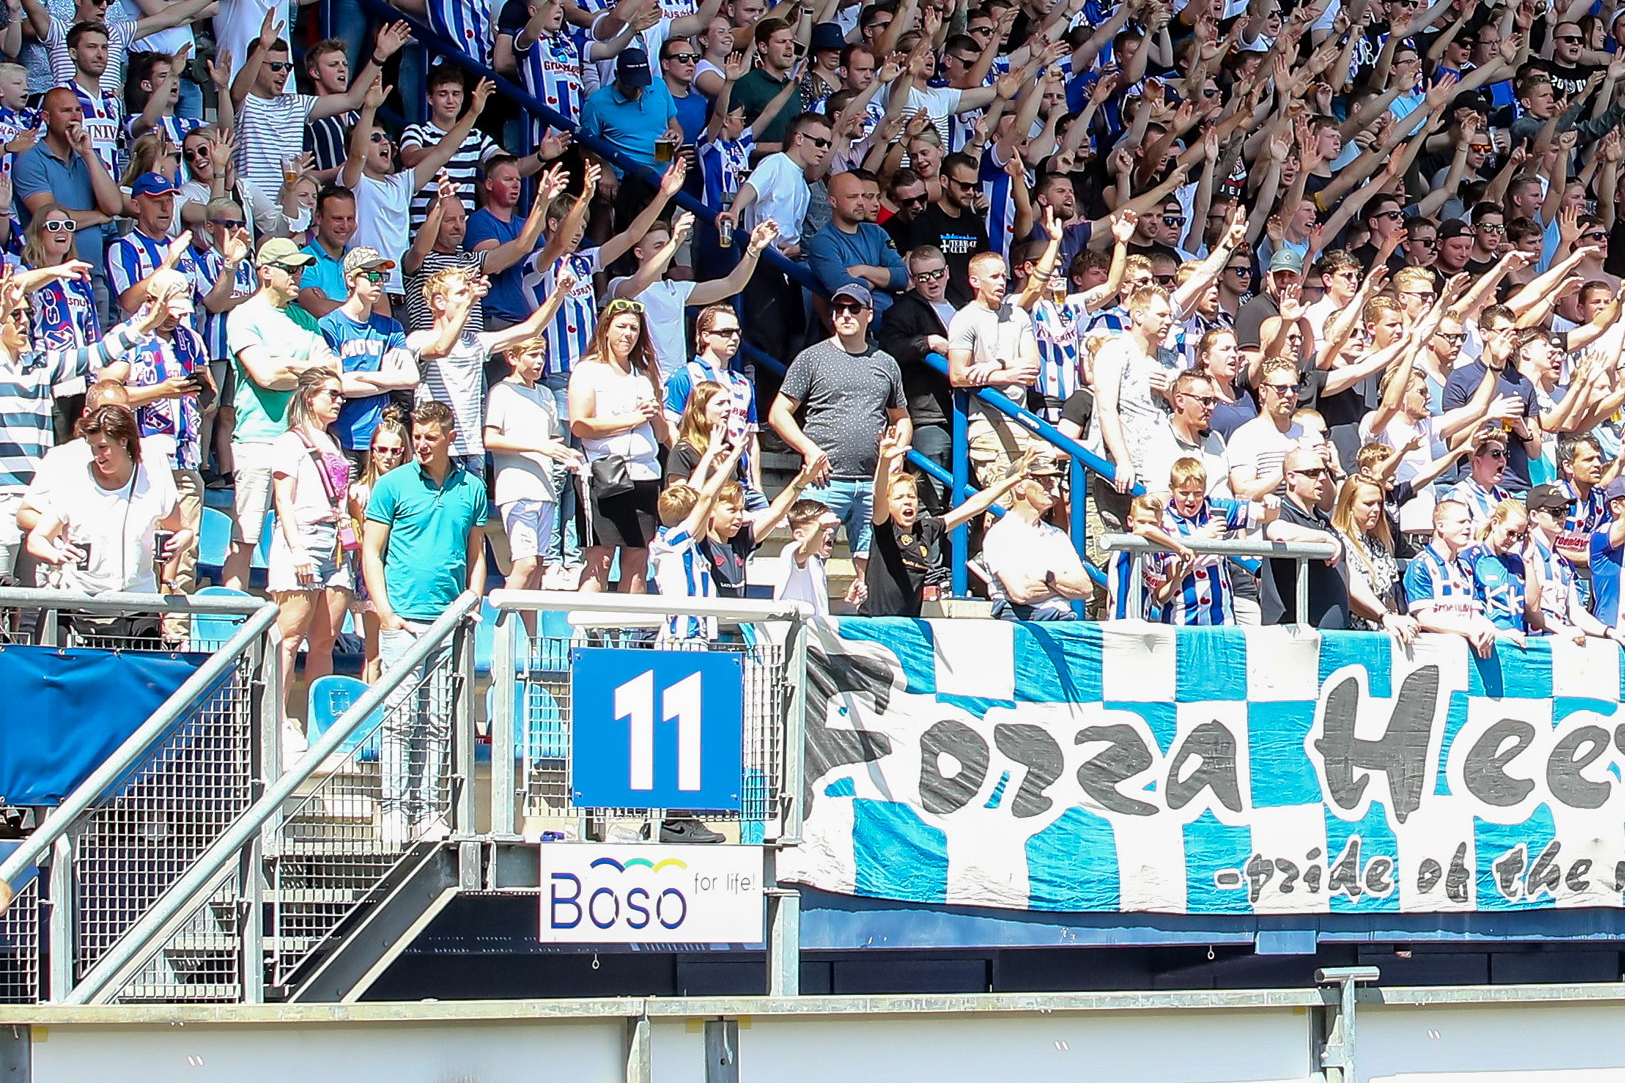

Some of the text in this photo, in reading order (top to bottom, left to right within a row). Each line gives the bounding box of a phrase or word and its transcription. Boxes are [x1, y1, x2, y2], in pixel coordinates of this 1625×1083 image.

[614, 669, 702, 792] 11
[803, 653, 1242, 816] Forza
[551, 872, 756, 930] Boso for life!
[1496, 841, 1592, 901] the
